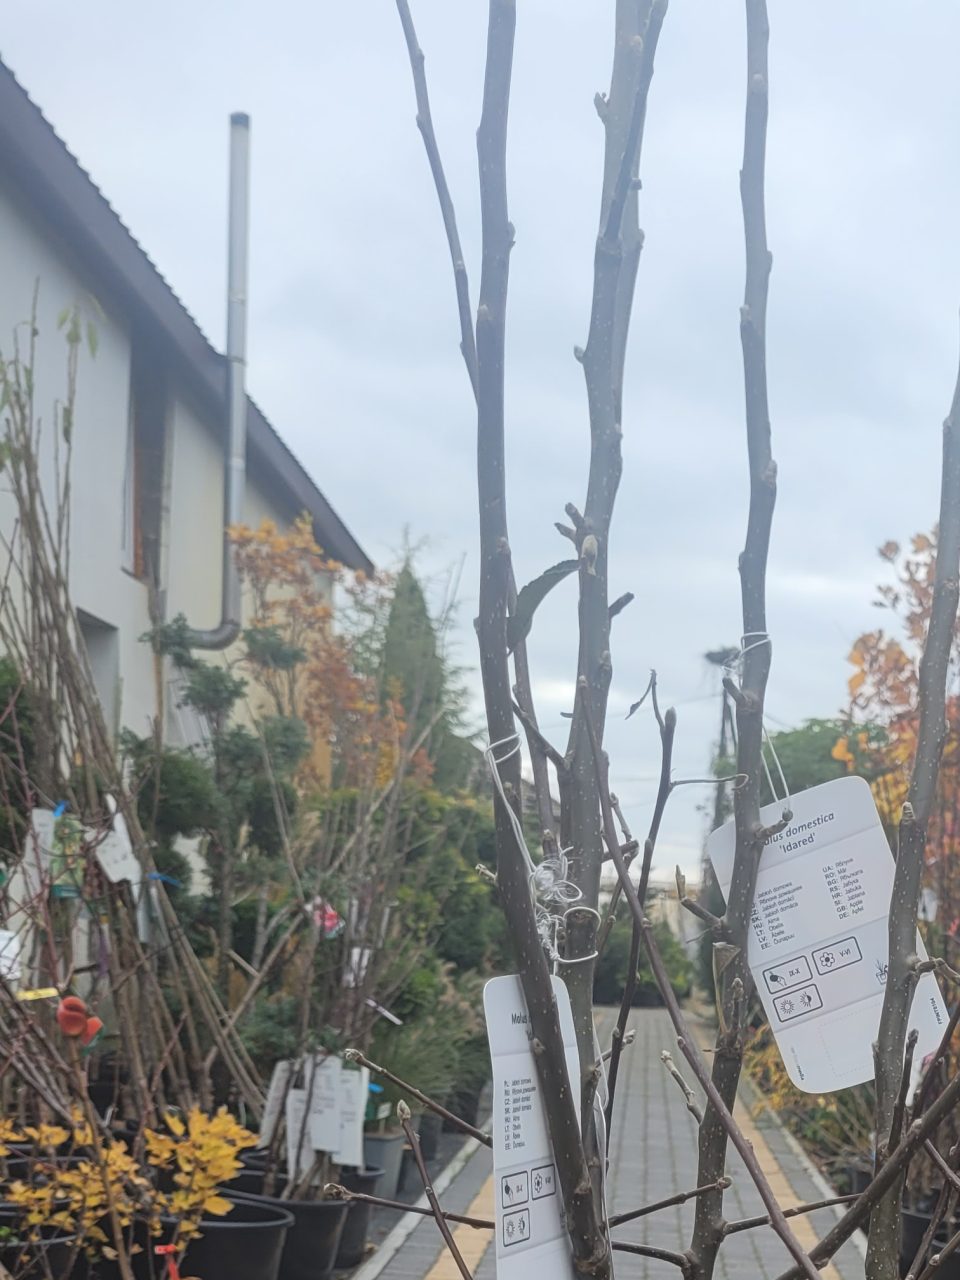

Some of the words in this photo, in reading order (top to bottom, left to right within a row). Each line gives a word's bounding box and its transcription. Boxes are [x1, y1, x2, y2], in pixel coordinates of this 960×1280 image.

[763, 832, 784, 846] alus
[786, 812, 835, 838] domestica
[779, 832, 816, 854] 'Idared'
